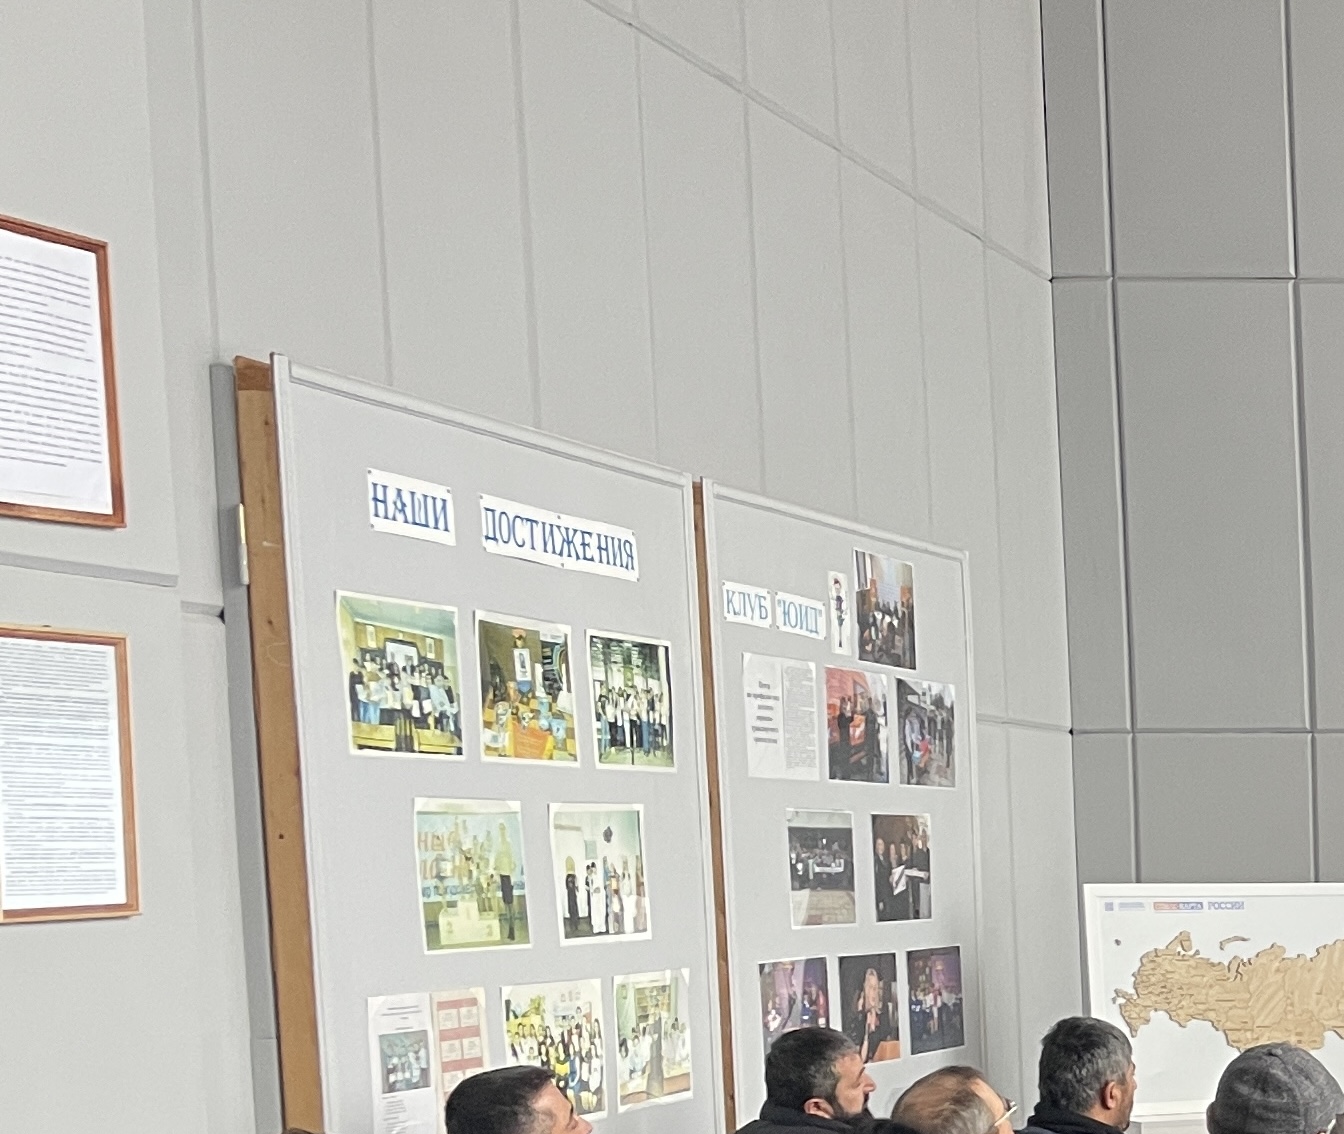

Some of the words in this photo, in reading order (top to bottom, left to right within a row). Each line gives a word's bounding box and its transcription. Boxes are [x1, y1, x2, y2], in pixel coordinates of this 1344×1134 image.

[371, 482, 450, 533] НАШИ
[483, 506, 635, 571] ДОСТИЖЕНИЯ
[726, 589, 768, 620] КЛУБ
